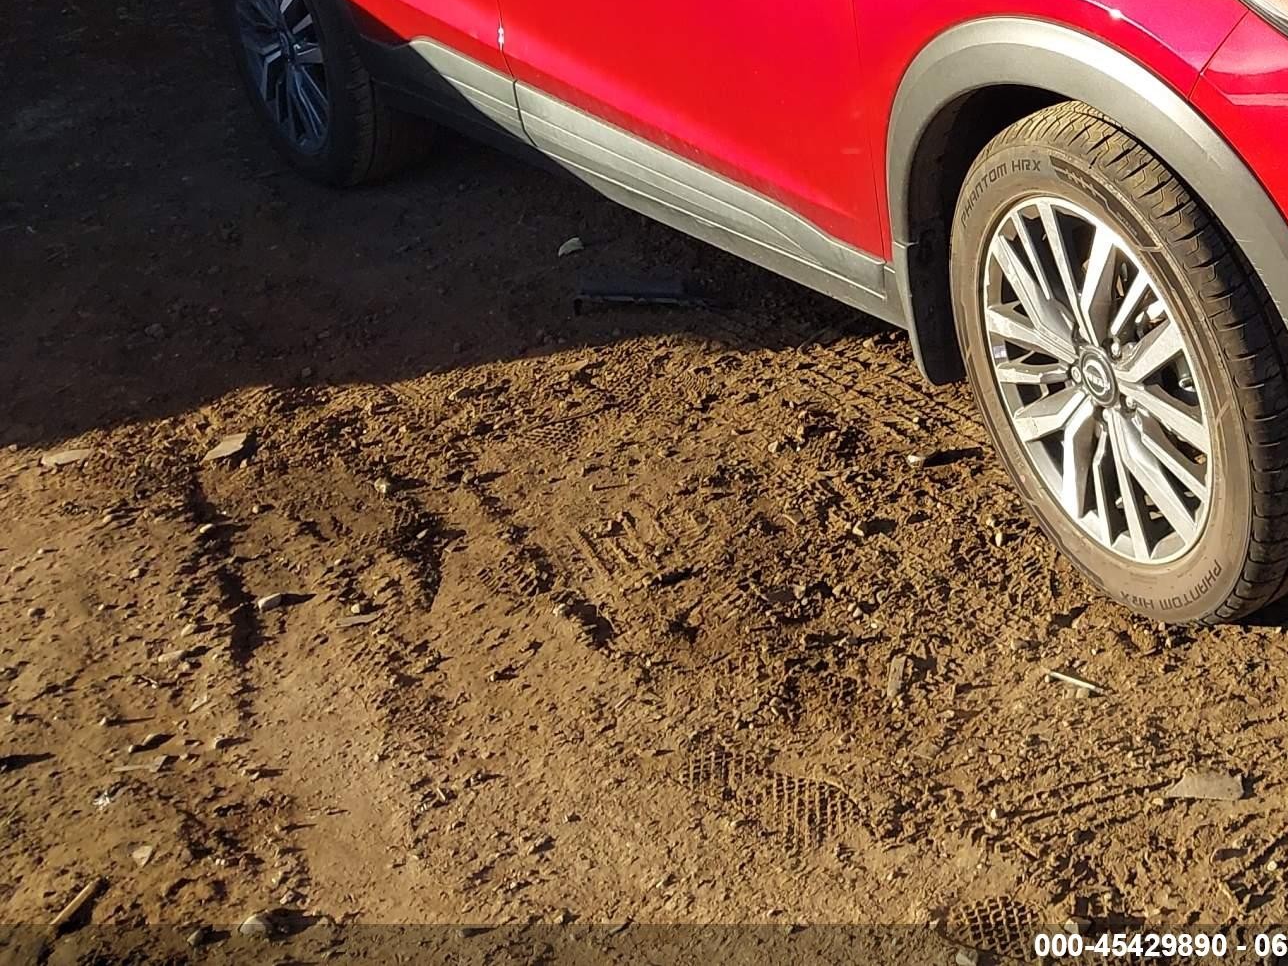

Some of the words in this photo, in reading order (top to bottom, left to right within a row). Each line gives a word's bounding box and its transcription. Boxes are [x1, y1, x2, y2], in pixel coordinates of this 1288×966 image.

[960, 161, 1008, 229] PHANTOM
[1011, 159, 1041, 173] HRX
[1159, 559, 1222, 611] PHANTOM
